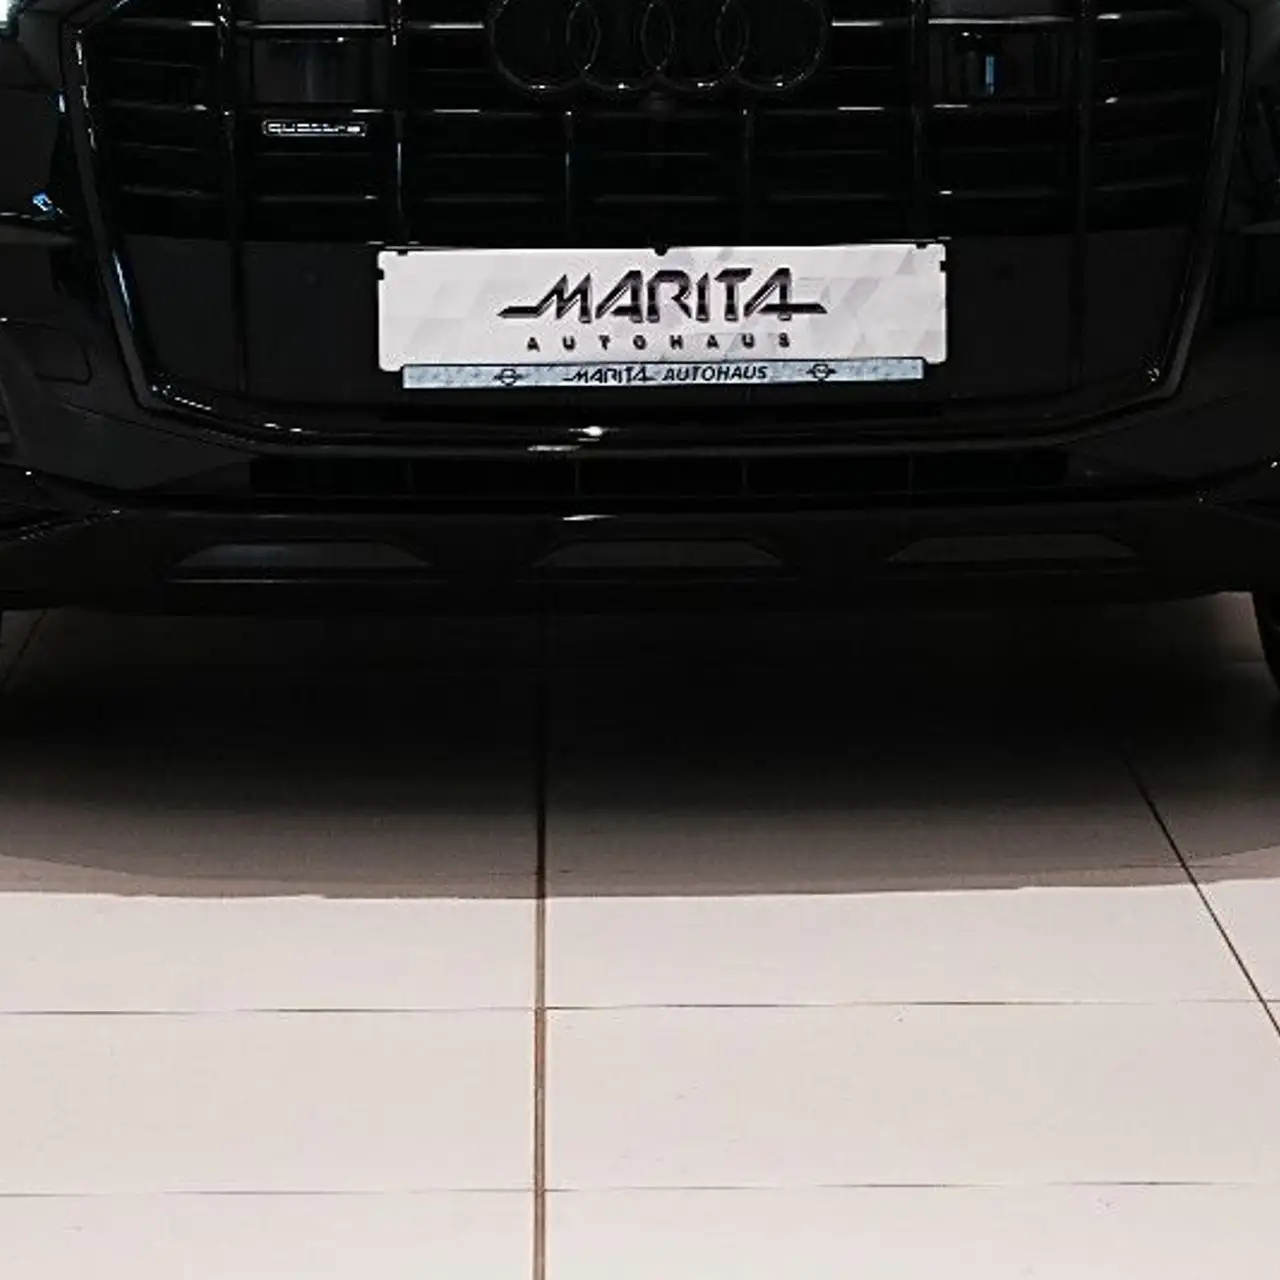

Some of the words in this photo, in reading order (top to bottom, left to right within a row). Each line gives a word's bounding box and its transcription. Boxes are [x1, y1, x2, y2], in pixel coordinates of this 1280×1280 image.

[496, 267, 828, 324] MARITA
[526, 332, 792, 352] AUTOHAUS
[561, 365, 657, 384] MARITA
[661, 364, 768, 382] AUTOHAUS
